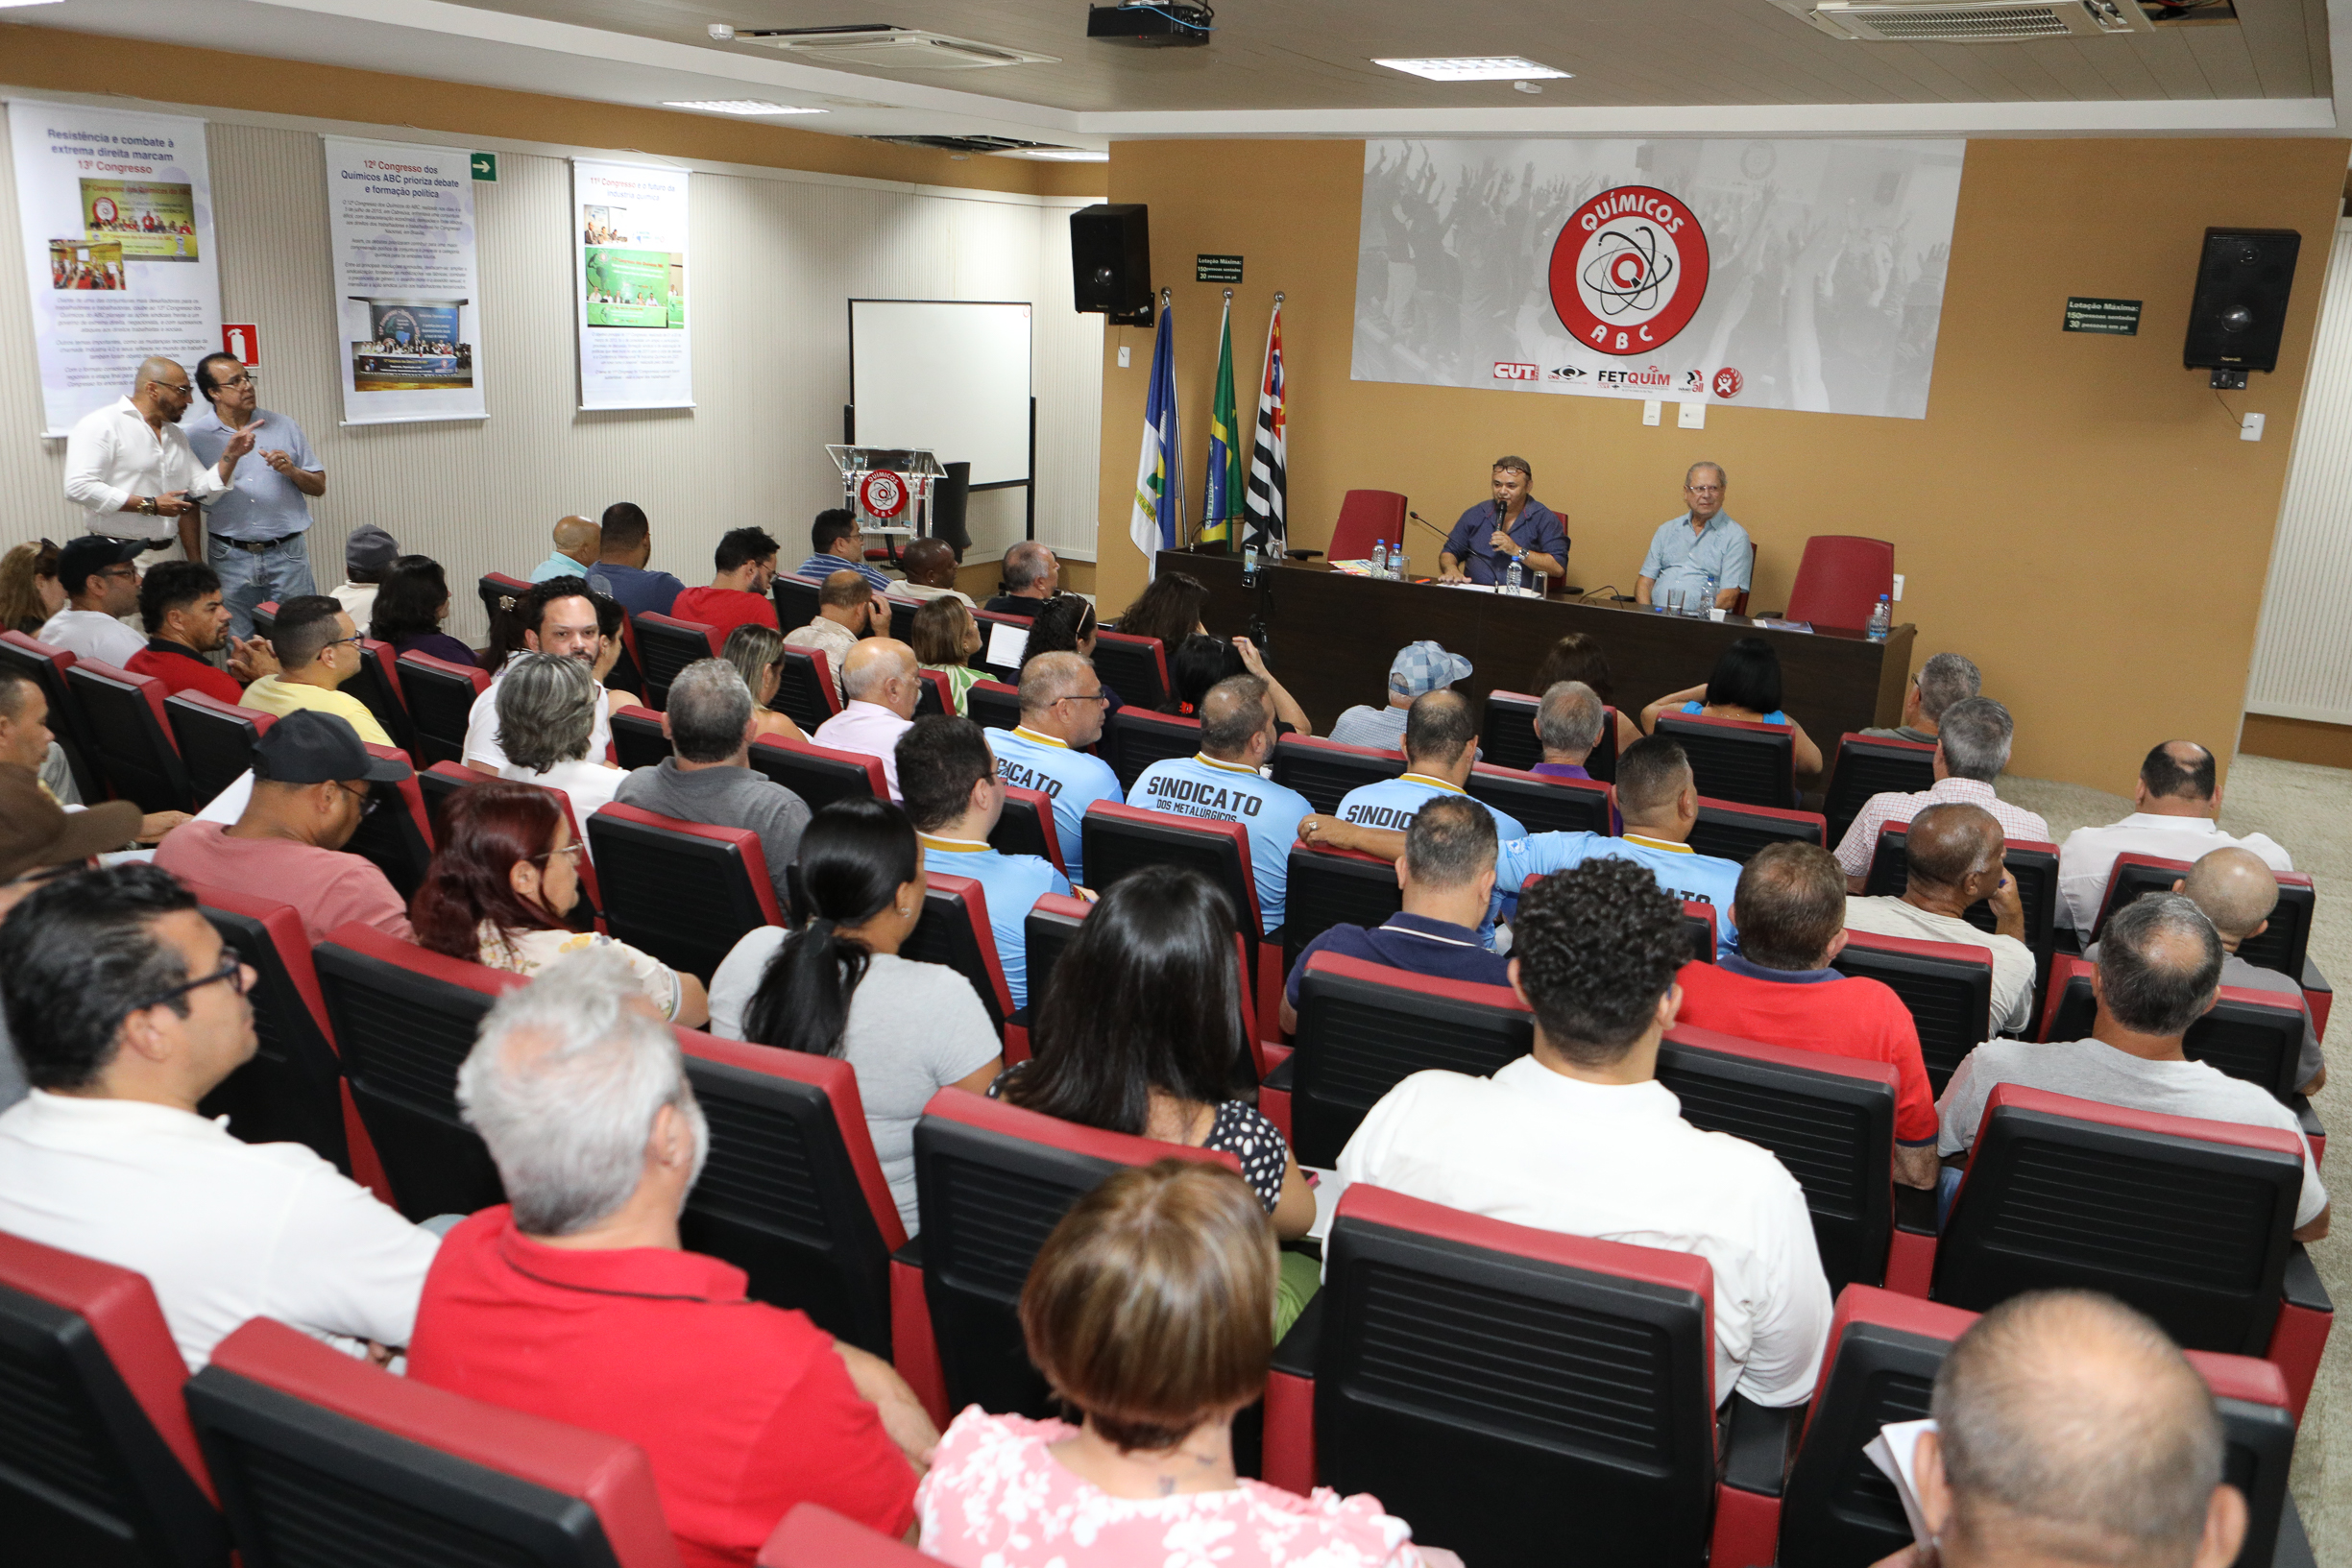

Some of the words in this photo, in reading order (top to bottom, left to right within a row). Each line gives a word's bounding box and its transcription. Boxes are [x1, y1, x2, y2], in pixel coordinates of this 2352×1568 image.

[48, 129, 109, 143] Resistência
[121, 136, 165, 147] combate
[168, 138, 174, 148] à
[52, 145, 94, 156] extrema
[98, 147, 129, 158] direita
[133, 152, 174, 161] marcam
[96, 161, 152, 174] Congresso
[364, 160, 376, 169] 12º
[378, 161, 422, 173] Congresso
[424, 165, 438, 174] dos
[341, 170, 381, 182] Químicos
[383, 174, 402, 183] ABC
[404, 176, 432, 186] prioriza
[434, 179, 459, 188] debate
[602, 178, 636, 188] Congresso
[648, 183, 666, 191] futuro
[372, 186, 410, 197] formação
[412, 188, 439, 198] política
[1581, 192, 1684, 233] QUÍMICOS
[2069, 301, 2102, 310] Lotação
[2103, 303, 2139, 311] Máxima:
[1494, 364, 1534, 379] CUT
[1598, 371, 1670, 385] FETQUIM
[868, 471, 899, 484] QUÍMICOS
[1147, 776, 1262, 817] SINDICATO
[1157, 799, 1172, 810] DOS
[1174, 802, 1237, 823] METALÚRGICOS
